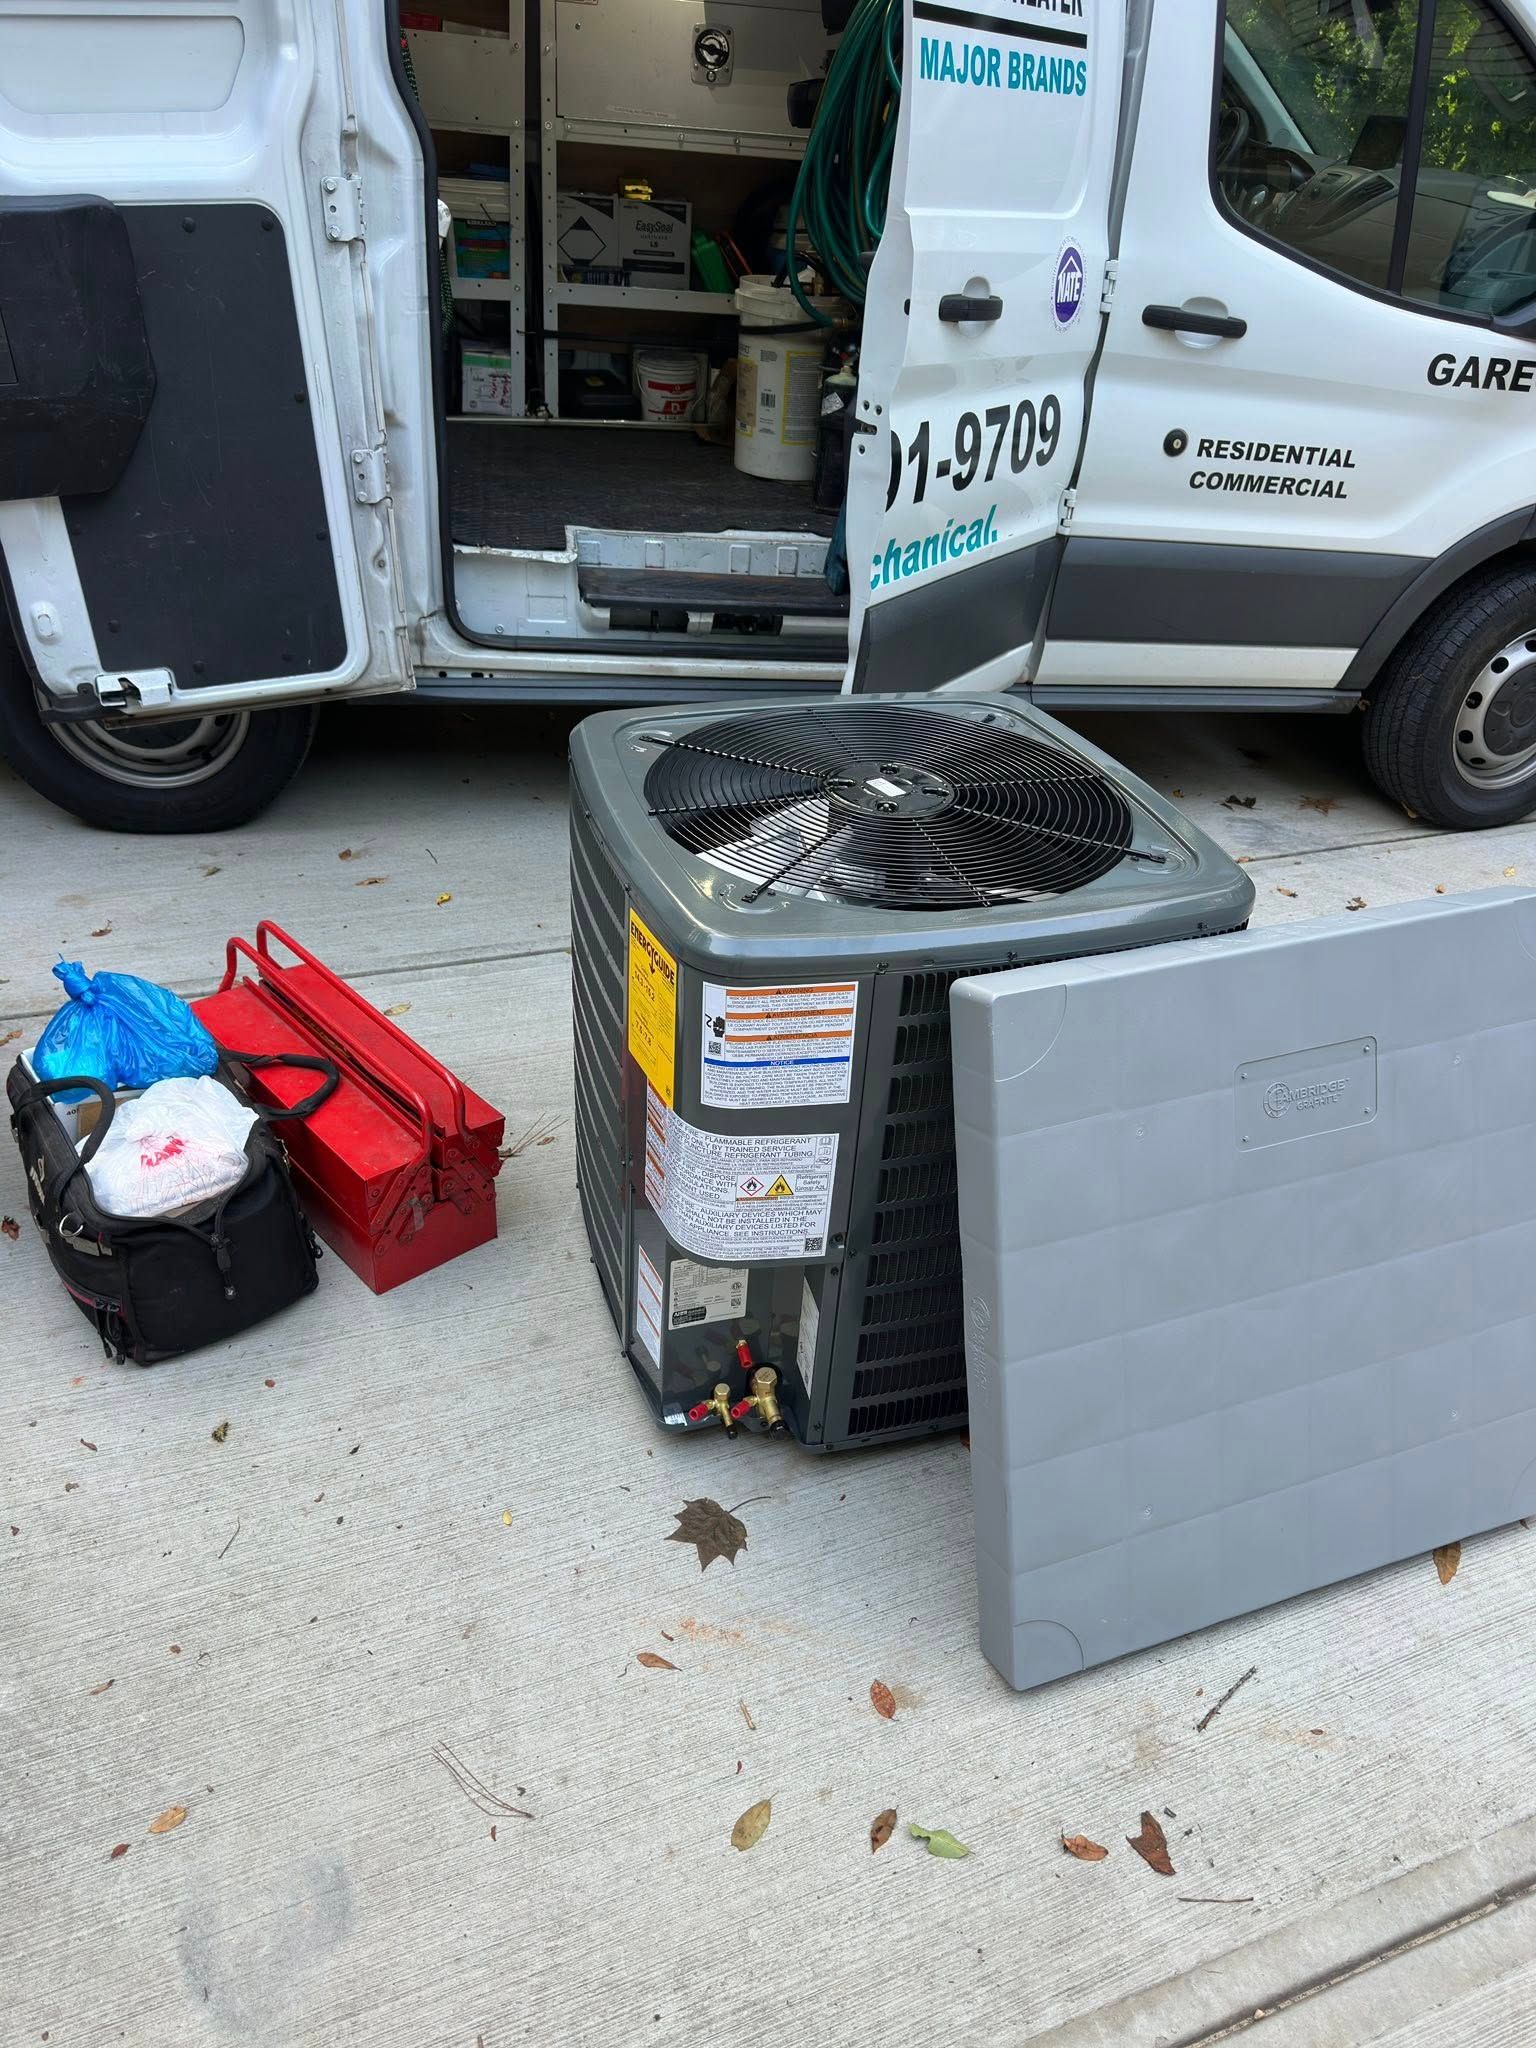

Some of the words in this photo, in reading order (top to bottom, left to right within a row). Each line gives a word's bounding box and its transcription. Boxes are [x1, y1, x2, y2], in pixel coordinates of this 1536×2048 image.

[920, 37, 1001, 87] MAJOR
[1007, 51, 1087, 97] BRANDS
[1057, 271, 1082, 303] NATE
[1196, 438, 1356, 469] RESIDENTIAL
[1189, 471, 1348, 499] COMMERCIAL
[704, 1135, 752, 1145] FLAMMABLE
[754, 1137, 810, 1145] REFRIGERANT
[711, 1143, 722, 1151] BY
[701, 1169, 735, 1181] DISPOSE
[715, 1179, 737, 1187] WITH
[700, 1206, 739, 1217] AUXILIARY
[776, 1209, 804, 1217] WHICH
[694, 1216, 734, 1230] AUXILIARY
[707, 1215, 724, 1224] NOT
[737, 1216, 780, 1224] INSTALLED
[792, 1215, 807, 1223] THE
